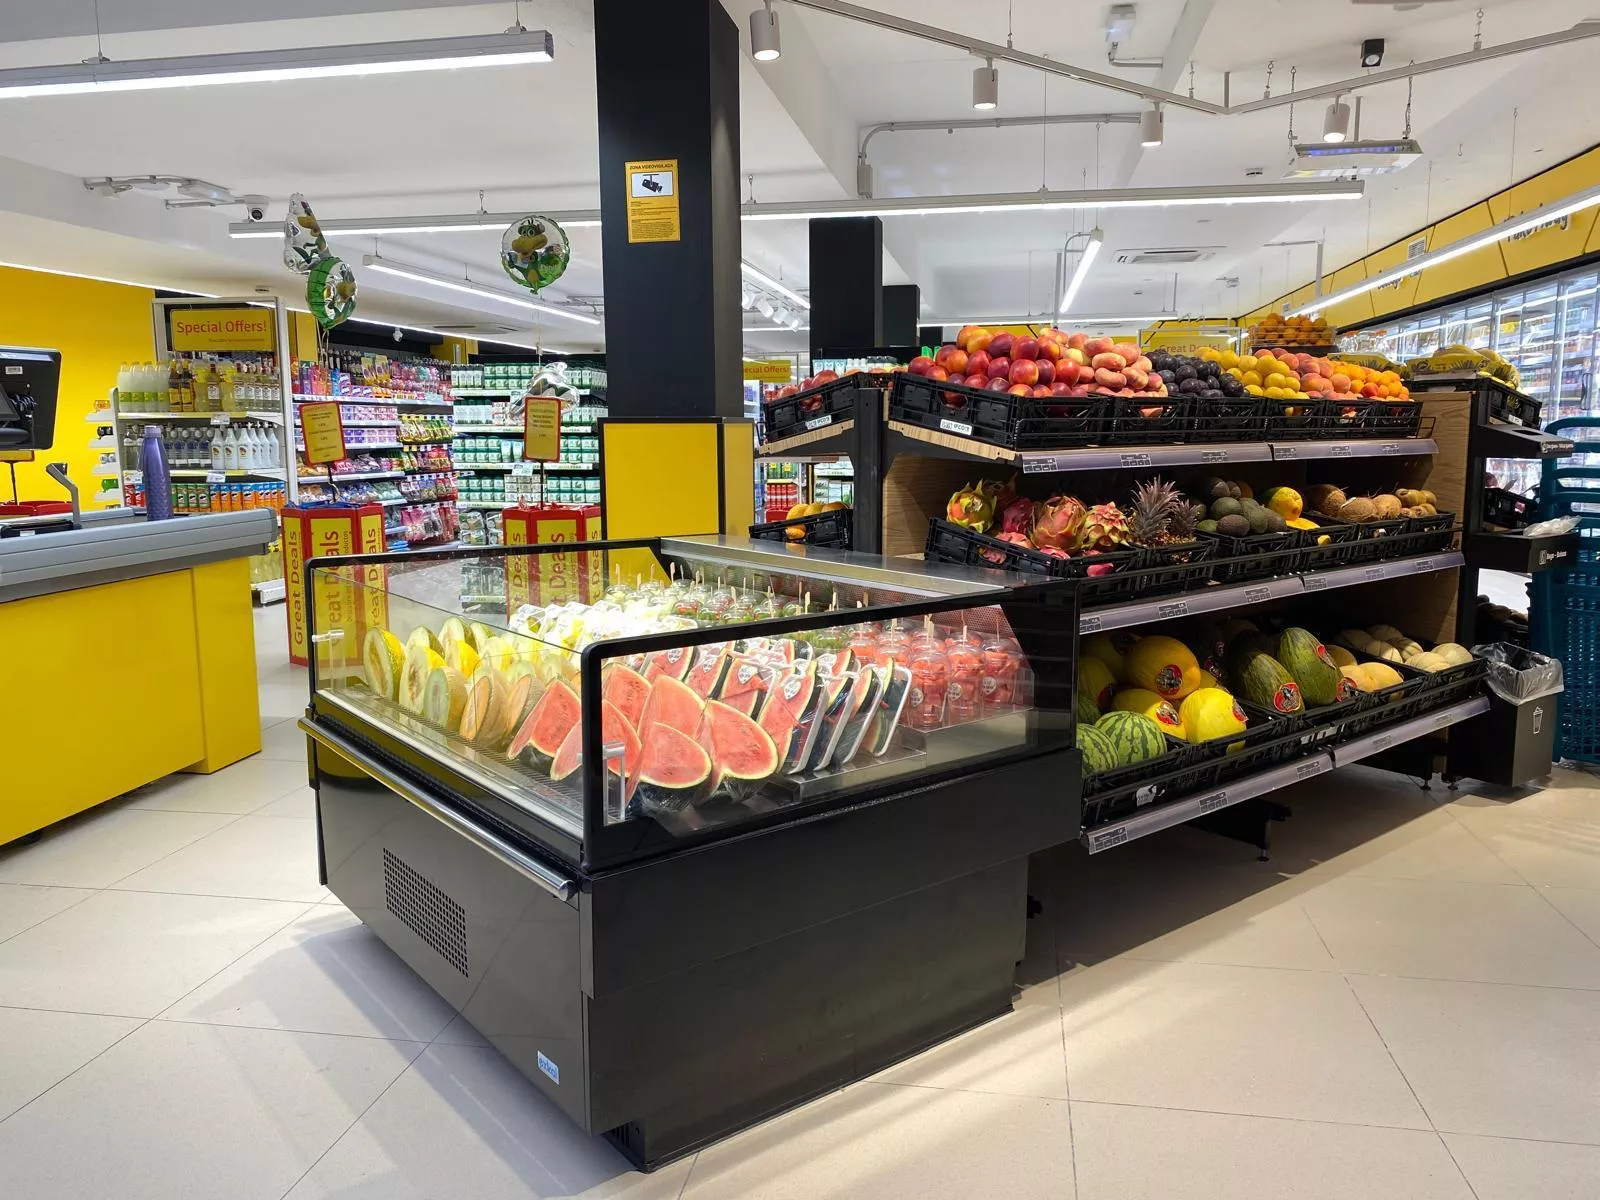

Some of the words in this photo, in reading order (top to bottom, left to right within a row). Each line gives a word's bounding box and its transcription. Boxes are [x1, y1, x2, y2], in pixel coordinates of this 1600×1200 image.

[177, 320, 222, 335] Special
[225, 320, 267, 332] Offers!
[1189, 343, 1220, 353] Des!
[744, 365, 762, 373] ecial
[288, 531, 299, 584] Deals
[366, 528, 378, 582] Dals
[513, 532, 523, 588] Deas
[549, 532, 567, 588] Deas
[592, 530, 600, 585] Deas
[293, 592, 302, 645] Great
[369, 588, 381, 627] reat
